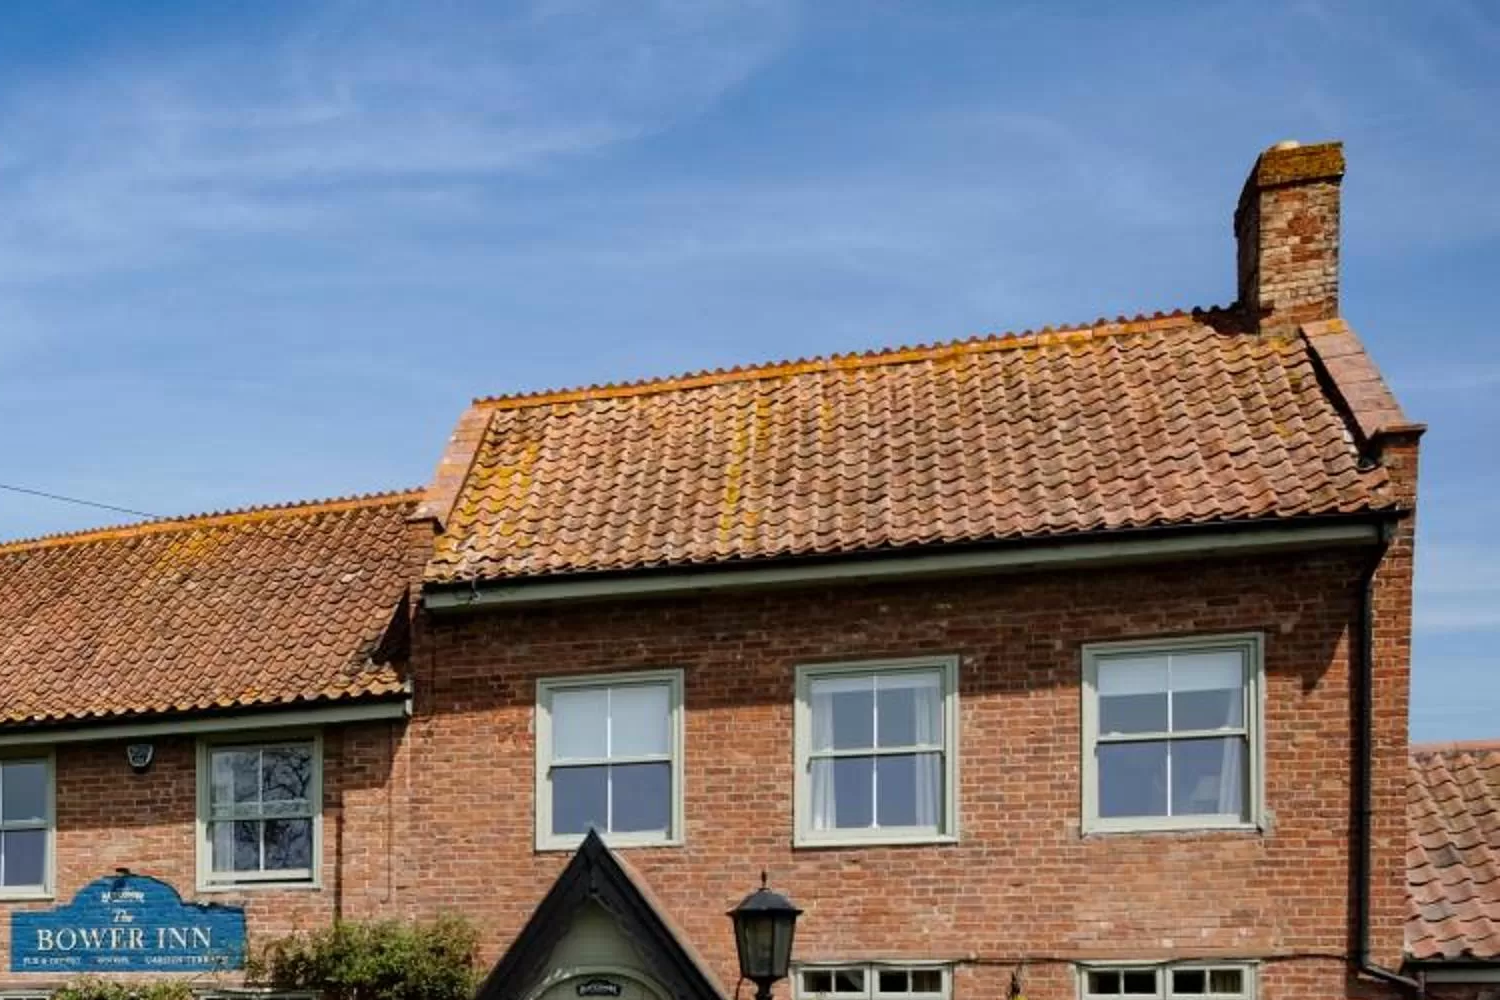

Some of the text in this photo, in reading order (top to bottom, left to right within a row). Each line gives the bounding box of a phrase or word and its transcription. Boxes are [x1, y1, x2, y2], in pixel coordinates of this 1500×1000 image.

[111, 908, 134, 923] The
[37, 927, 213, 951] BOWER INN
